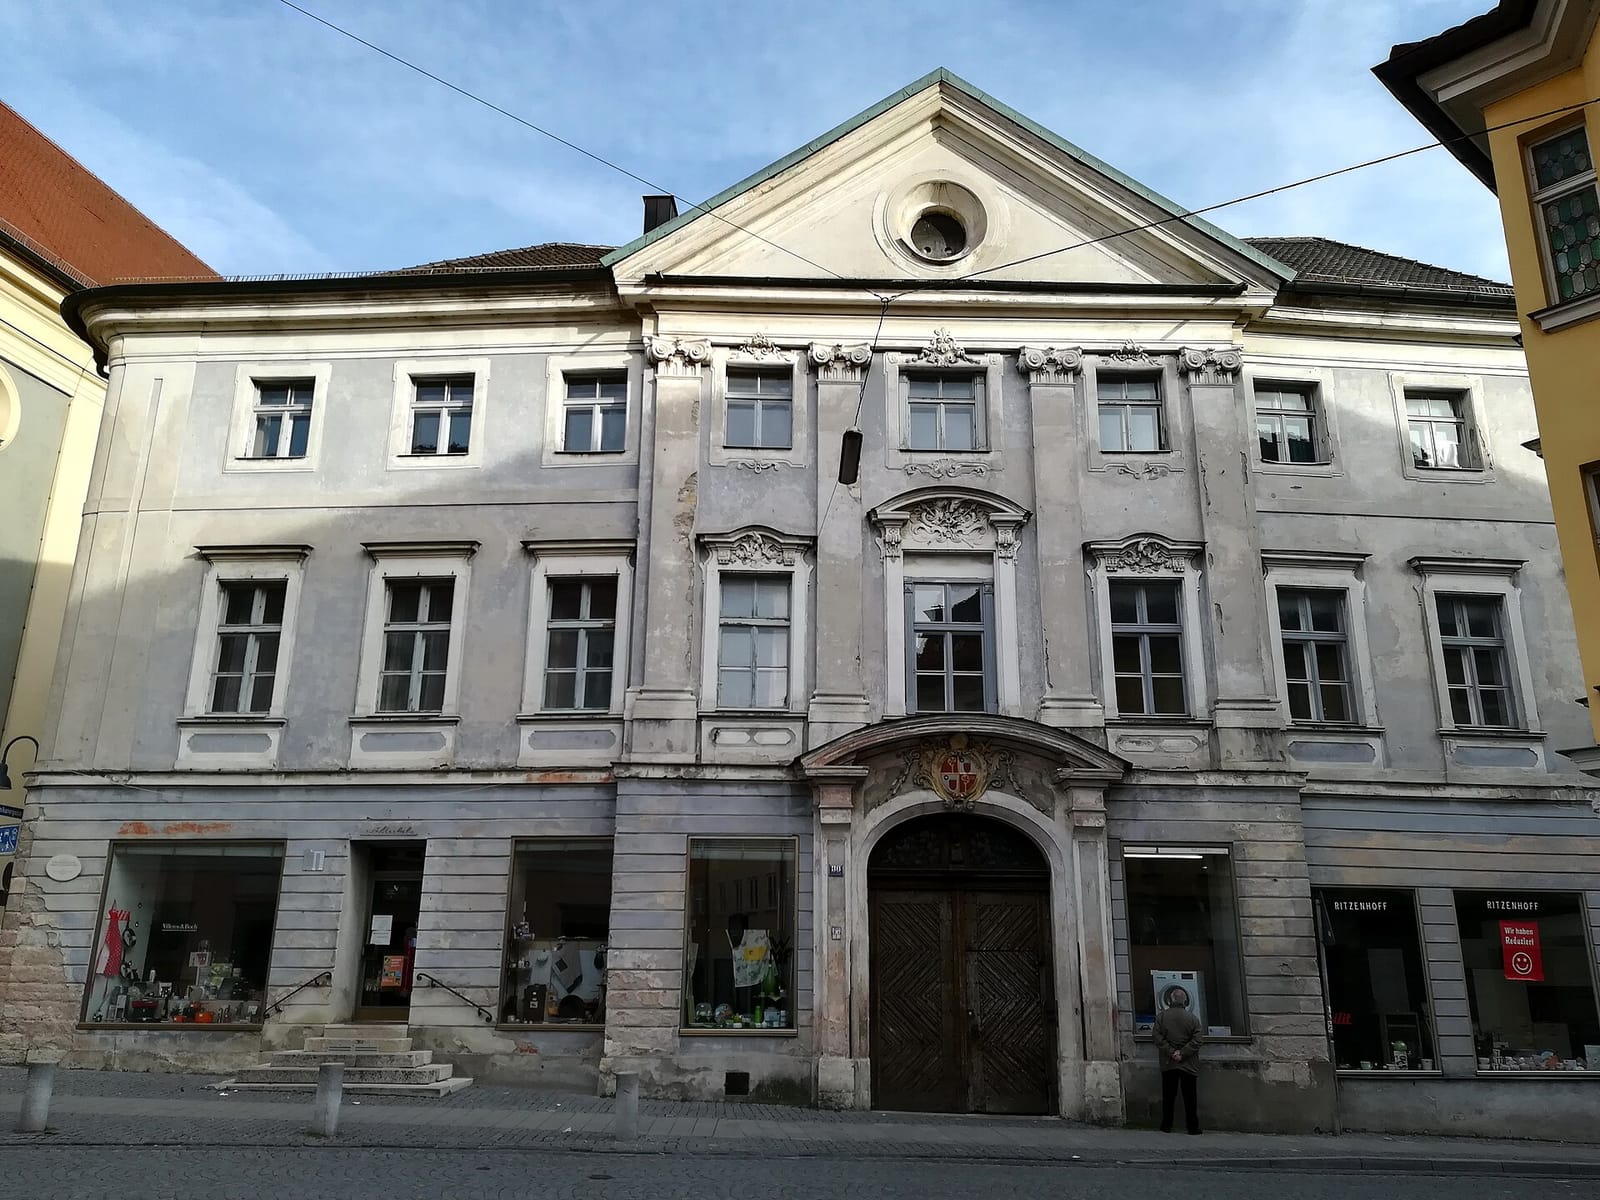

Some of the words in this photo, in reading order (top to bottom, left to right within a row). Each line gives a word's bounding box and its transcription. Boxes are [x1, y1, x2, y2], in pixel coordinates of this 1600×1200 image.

[1334, 901, 1387, 911] RITZENHOFF
[1486, 900, 1539, 911] RITZENHOFF
[1504, 927, 1515, 935] Wir
[1515, 927, 1534, 936] haben
[1505, 936, 1535, 946] Reduziert
